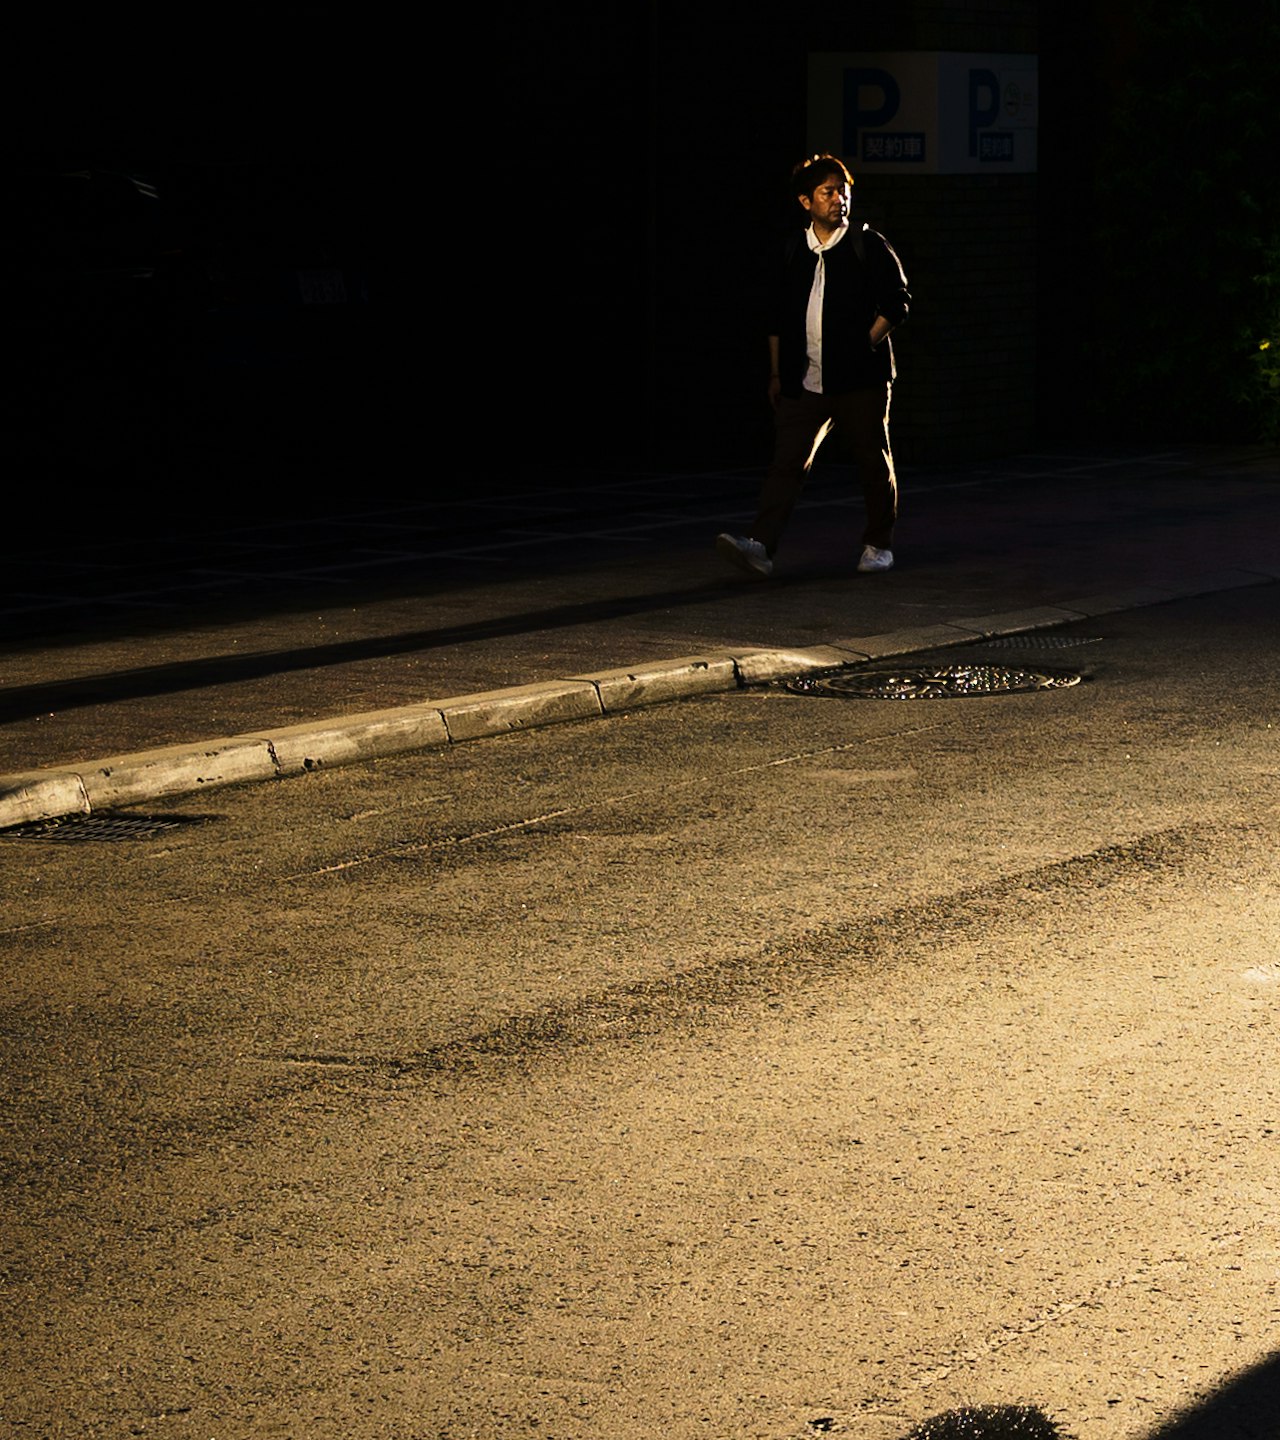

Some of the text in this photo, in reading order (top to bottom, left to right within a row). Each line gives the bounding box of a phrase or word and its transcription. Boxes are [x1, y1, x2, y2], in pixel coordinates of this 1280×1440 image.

[843, 68, 899, 156] P
[865, 137, 922, 158] 契約車
[969, 68, 1000, 157] P
